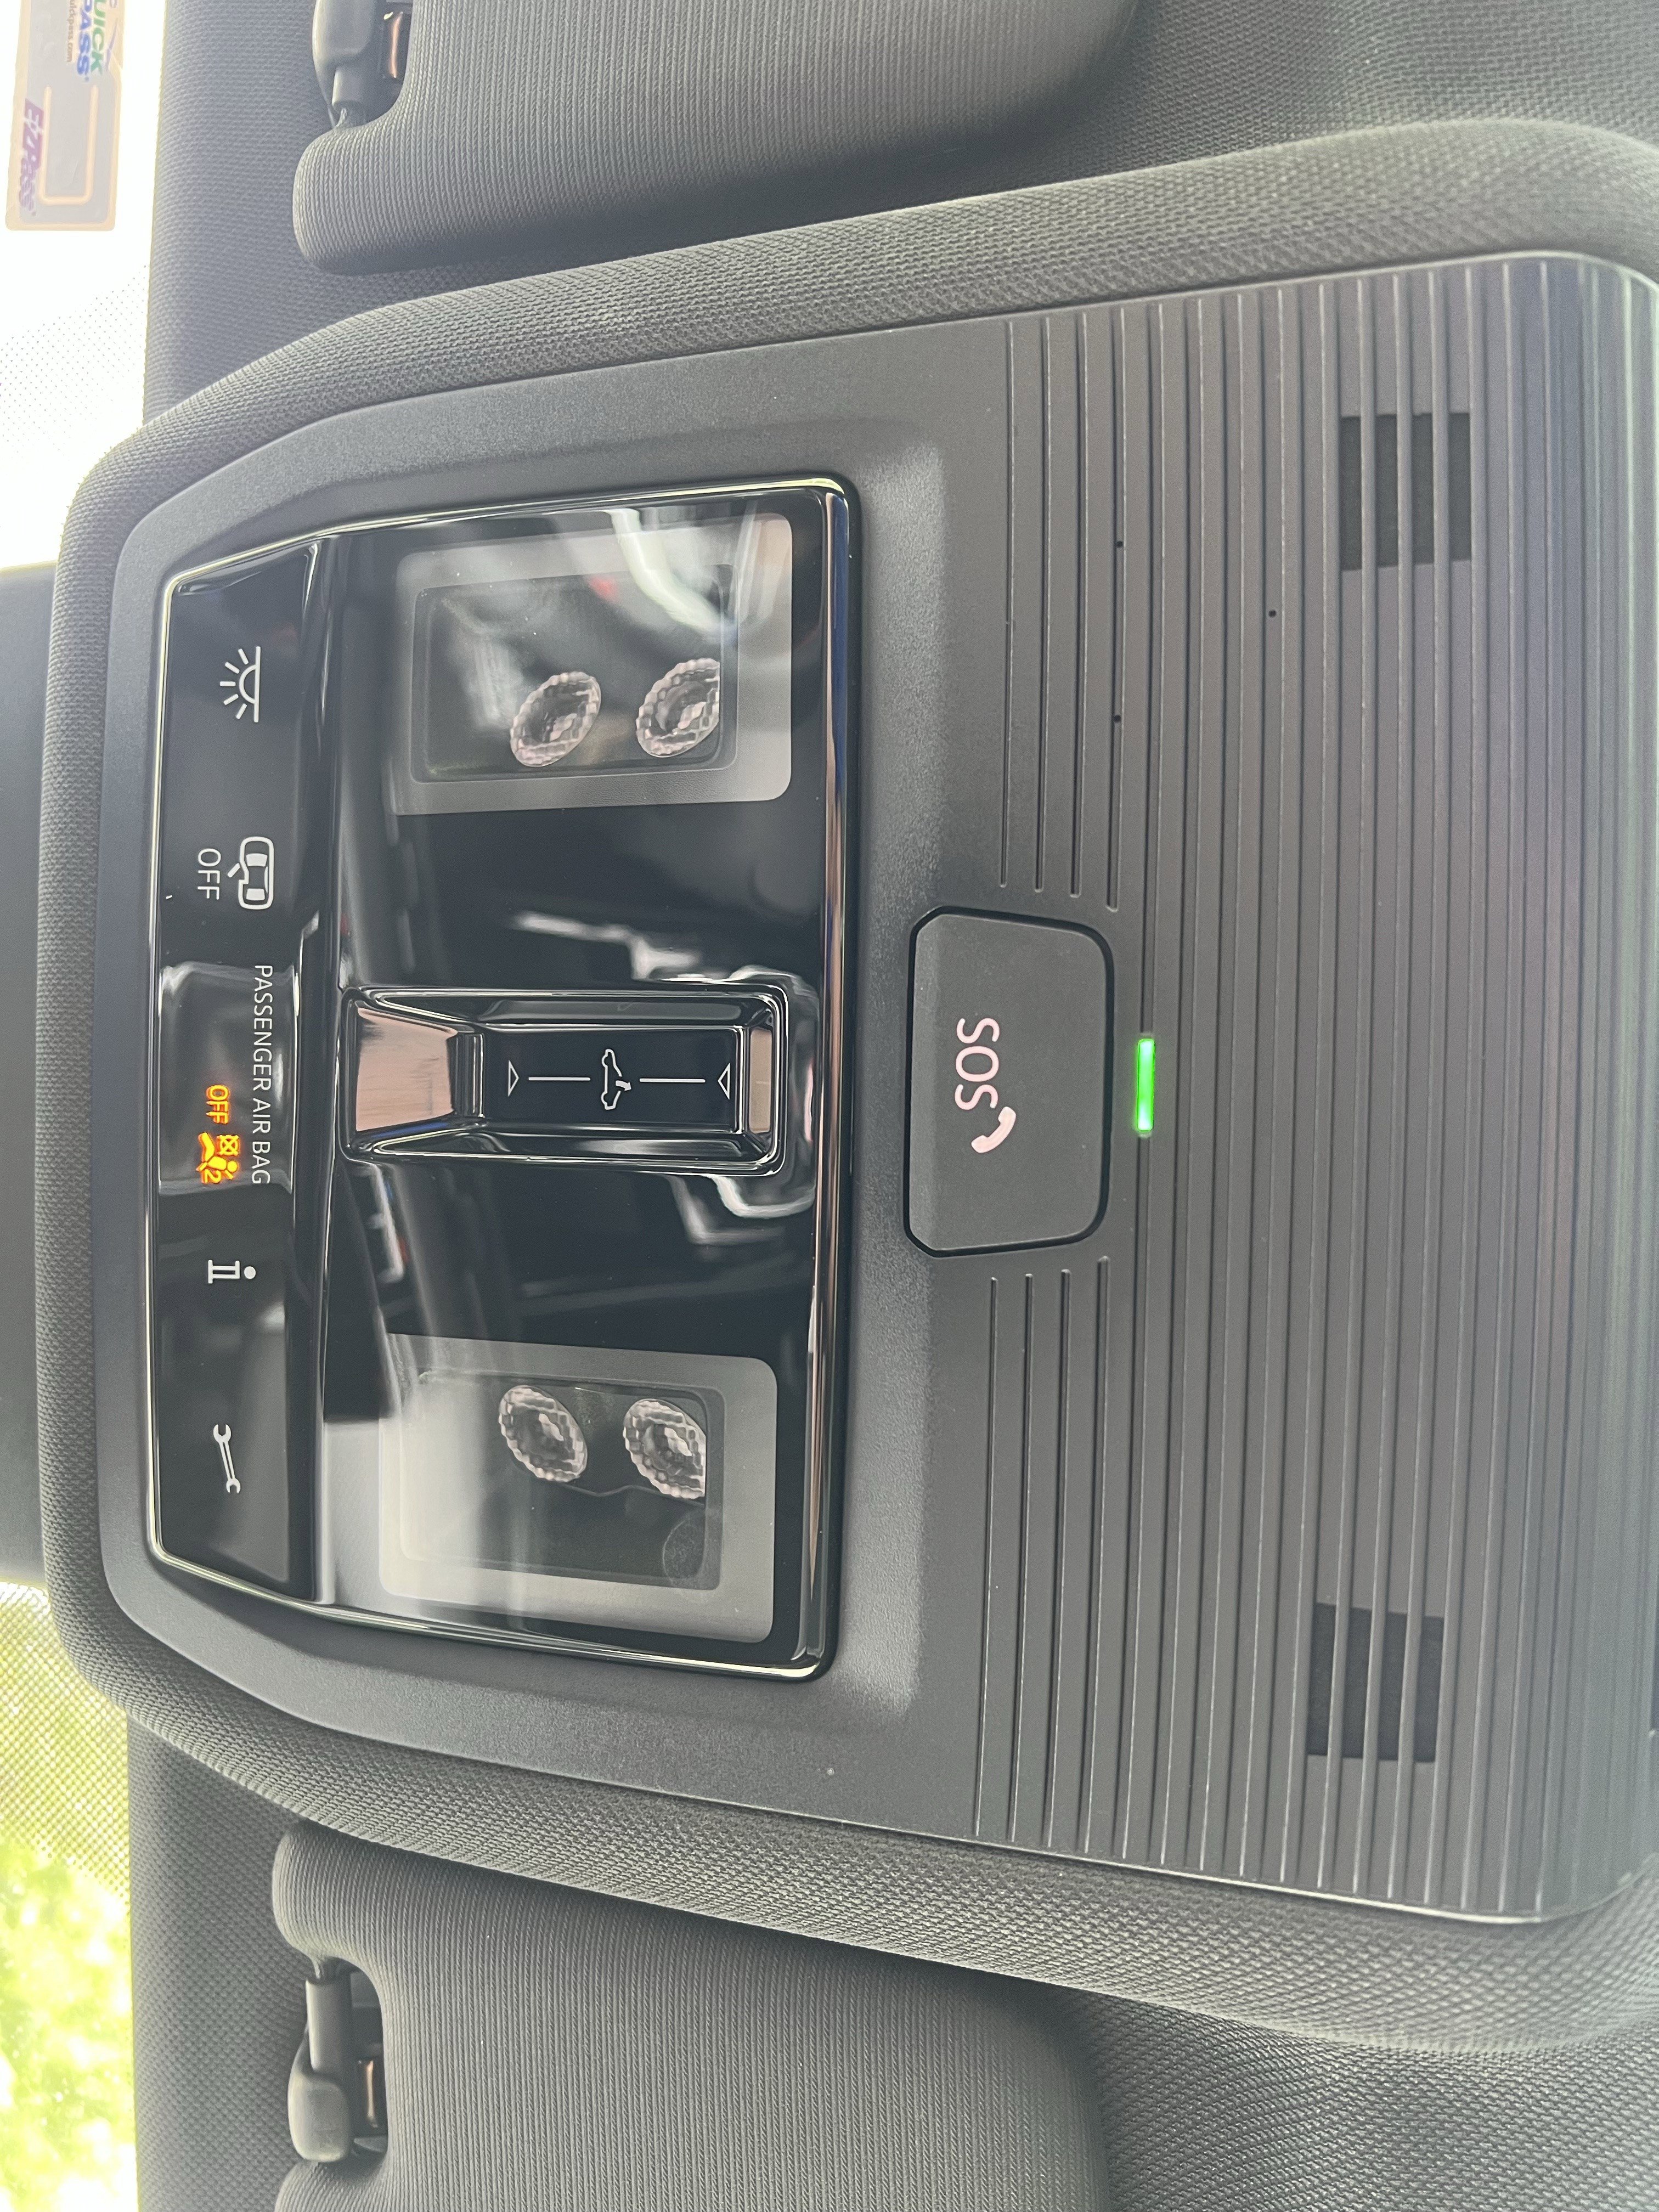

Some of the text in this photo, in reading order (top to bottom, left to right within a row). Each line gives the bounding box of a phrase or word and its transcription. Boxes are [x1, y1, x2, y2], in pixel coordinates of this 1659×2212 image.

[67, 0, 77, 63] uickpass.com
[91, 0, 106, 76] UICK
[197, 848, 222, 900] OFF
[251, 964, 273, 1184] PASSENGER AIR BAG
[955, 1018, 1000, 1110] SOS
[206, 1084, 230, 1124] OFF
